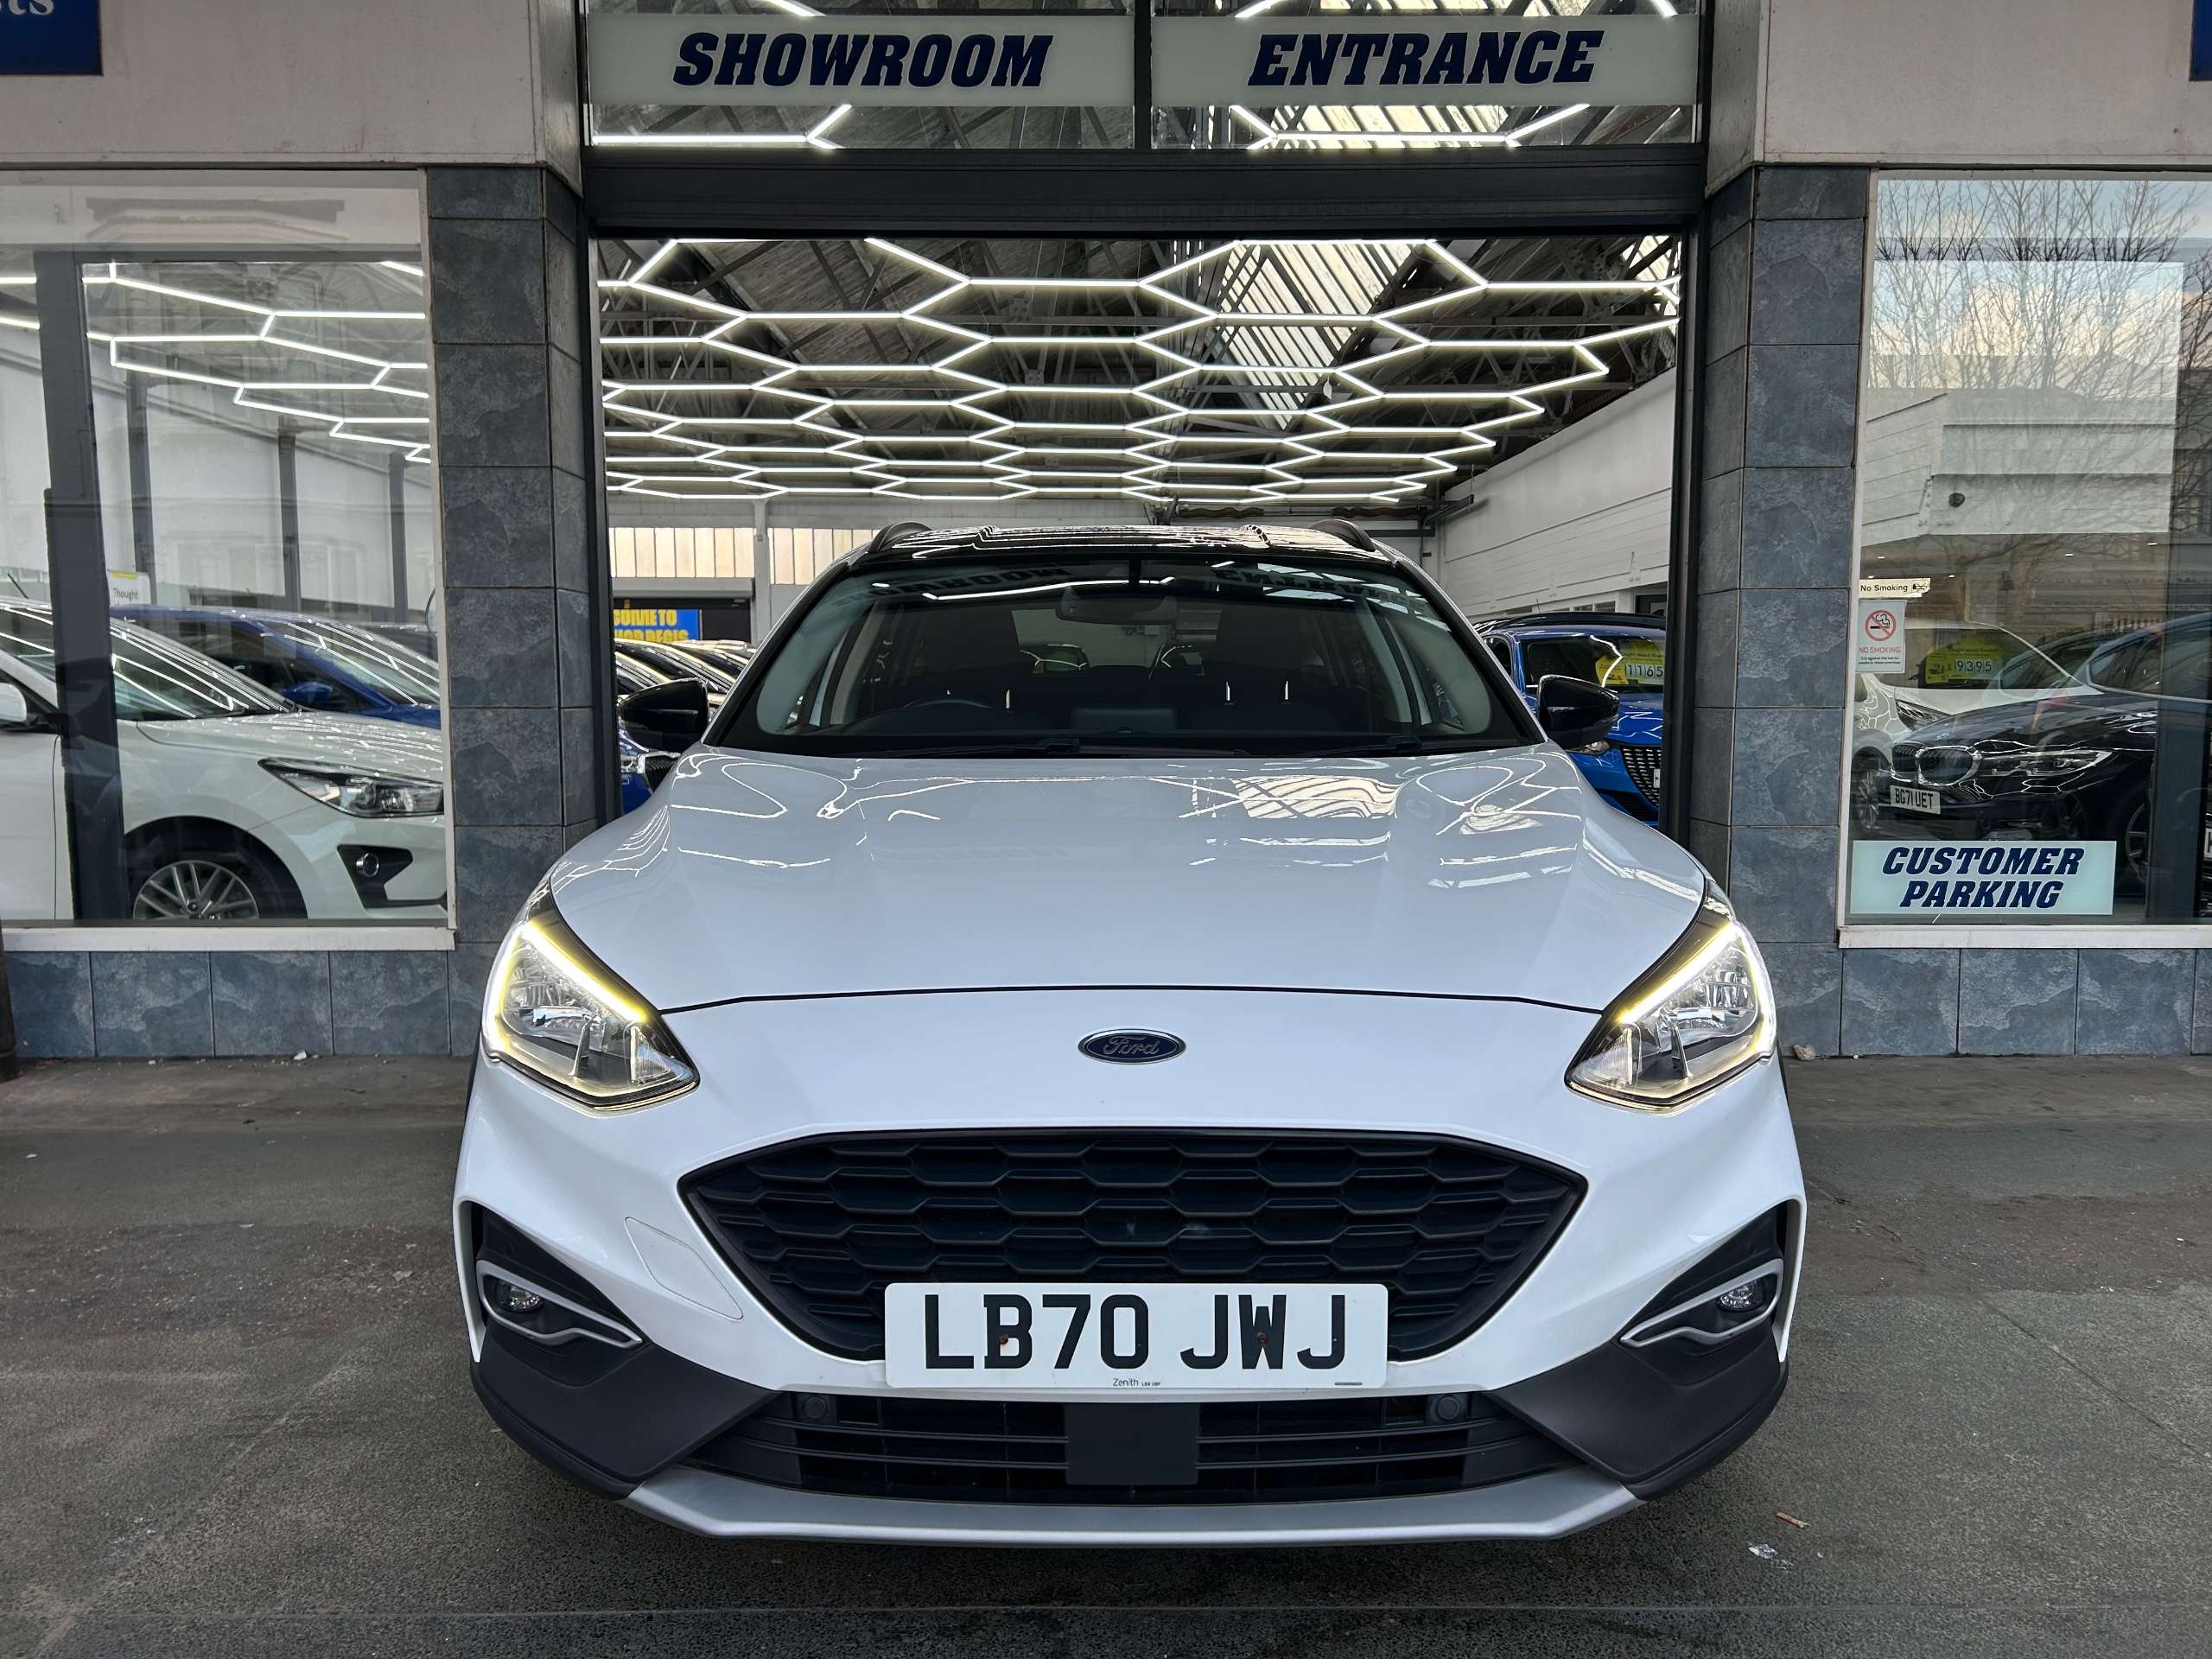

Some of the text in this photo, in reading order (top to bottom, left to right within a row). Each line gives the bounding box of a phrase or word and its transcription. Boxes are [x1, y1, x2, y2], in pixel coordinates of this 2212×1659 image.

[672, 32, 1054, 88] SHOWROOM
[1247, 29, 1605, 86] ENTRANCE
[112, 587, 138, 602] Thought
[1874, 584, 1909, 593] Smoking
[658, 608, 677, 626] TO
[1956, 659, 1992, 672] 9395
[1894, 787, 1934, 809] BG71 UET
[1882, 846, 2085, 875] CUSTOMER
[1898, 880, 2064, 909] PARKING
[1103, 1036, 1160, 1055] Ford
[924, 1294, 1346, 1370] LB70 JWJ
[1112, 1377, 1139, 1387] Zenith
